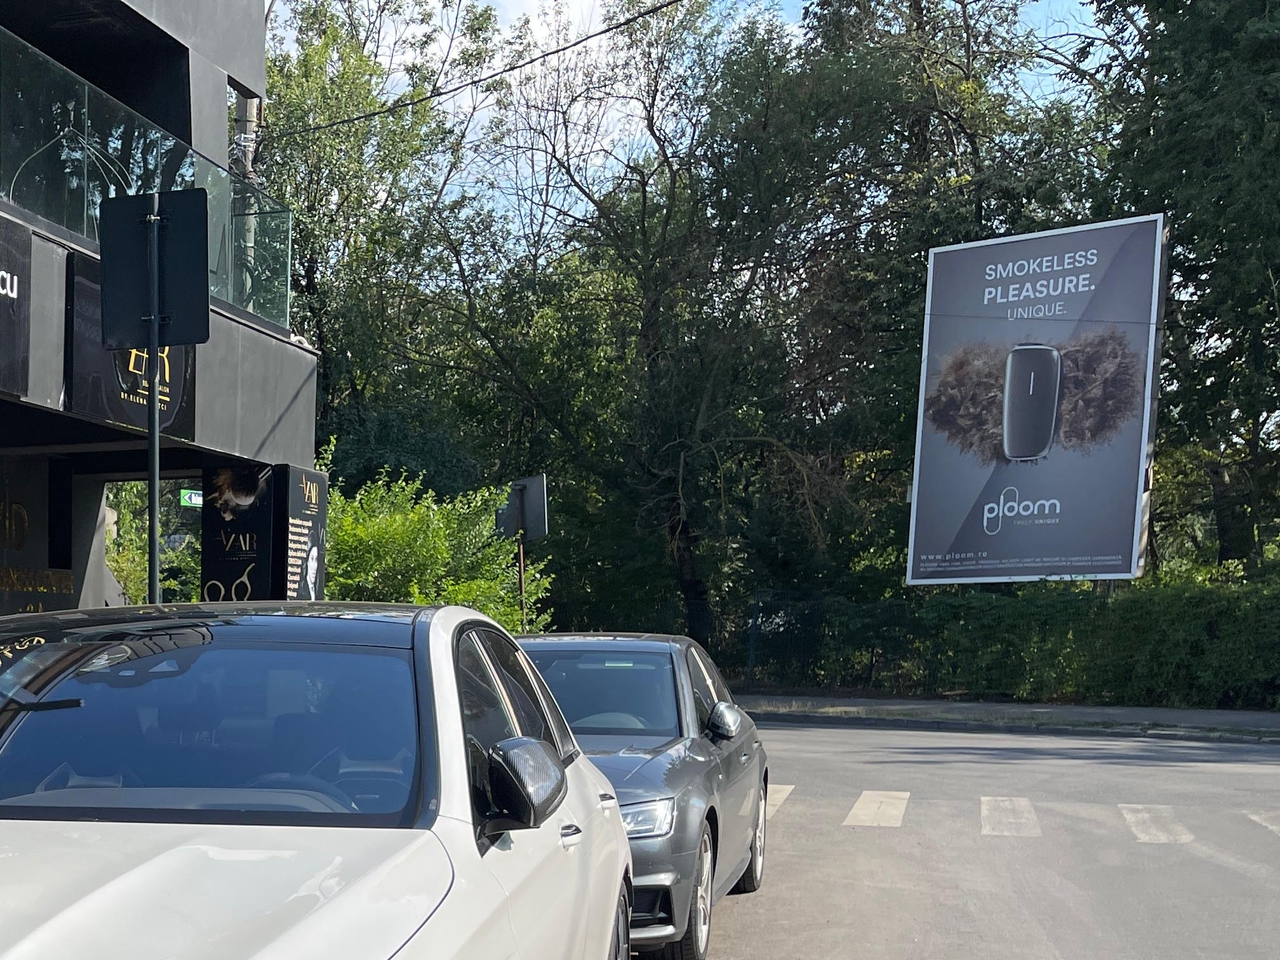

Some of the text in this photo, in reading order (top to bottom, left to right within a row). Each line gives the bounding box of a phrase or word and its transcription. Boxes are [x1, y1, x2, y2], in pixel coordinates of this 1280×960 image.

[984, 249, 1098, 280] SMOKELESS
[983, 273, 1096, 305] PLEASURE.
[1007, 301, 1067, 321] UNIQUE.
[983, 486, 1061, 535] ploom
